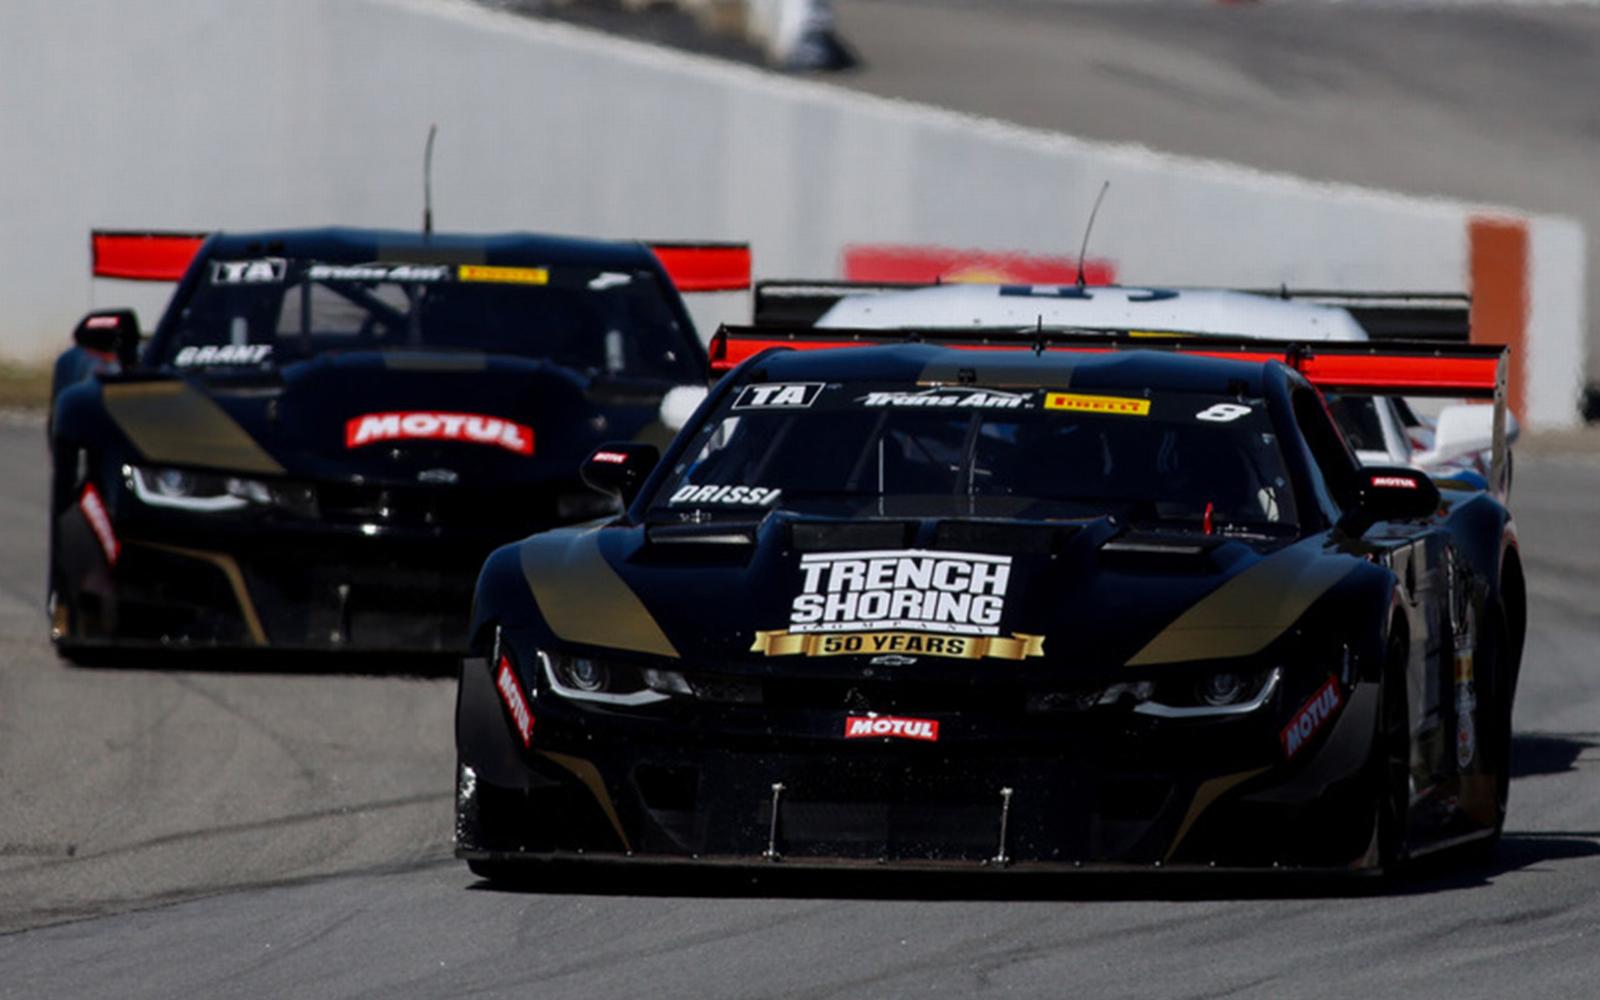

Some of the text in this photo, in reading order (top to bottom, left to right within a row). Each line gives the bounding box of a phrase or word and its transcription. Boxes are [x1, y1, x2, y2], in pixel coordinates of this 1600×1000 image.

[225, 261, 274, 281] TA
[174, 345, 272, 366] GRANT
[750, 386, 807, 406] TA
[864, 392, 959, 406] Trans
[957, 393, 1023, 408] Am
[1196, 404, 1252, 422] 8
[355, 414, 525, 449] MOTUL
[669, 485, 781, 505] DRISSI
[800, 558, 1010, 595] TRENCH
[790, 590, 1003, 625] SHORING
[824, 636, 965, 655] 50 YEARS
[498, 667, 530, 741] MOTUL
[850, 719, 934, 737] MOTUL
[1286, 683, 1339, 755] MOTUL
